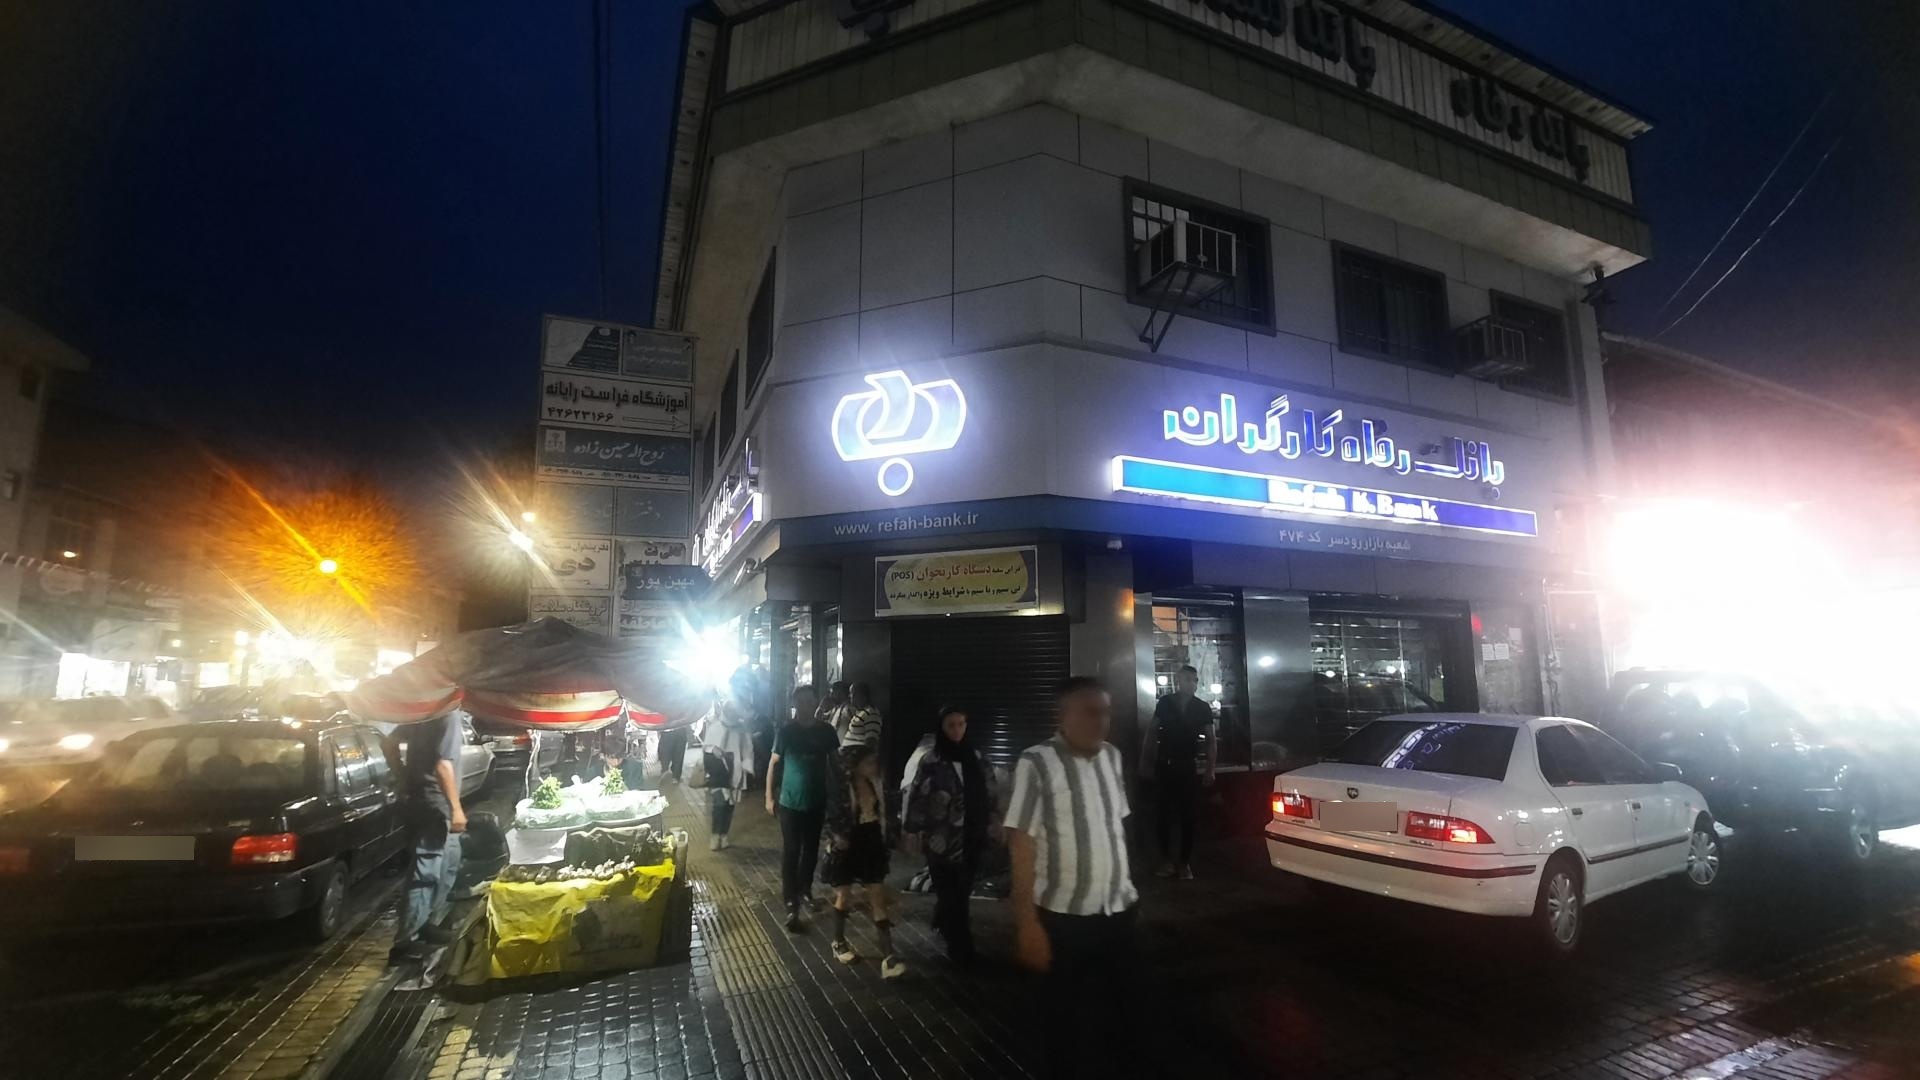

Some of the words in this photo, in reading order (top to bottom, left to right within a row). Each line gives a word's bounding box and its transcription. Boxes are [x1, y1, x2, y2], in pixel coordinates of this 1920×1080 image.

[1450, 76, 1524, 143] رفاه
[546, 381, 578, 403] رایانه
[581, 386, 629, 408] فراست
[632, 390, 689, 413] آموزشگاه
[547, 407, 614, 422] ۴۲۶۲۳۱۶۶
[1163, 393, 1343, 460] کارگران
[1341, 419, 1411, 476] رفاه
[1413, 437, 1505, 501] بانک
[1279, 529, 1304, 543] ۴۷۴
[1307, 529, 1321, 543] کد
[1328, 535, 1363, 551] رودسر
[1363, 537, 1385, 552] بازار
[1385, 538, 1411, 552] شعبه
[891, 571, 914, 582] (POS)
[963, 563, 991, 576] دستگاه
[942, 586, 965, 597] شرایط
